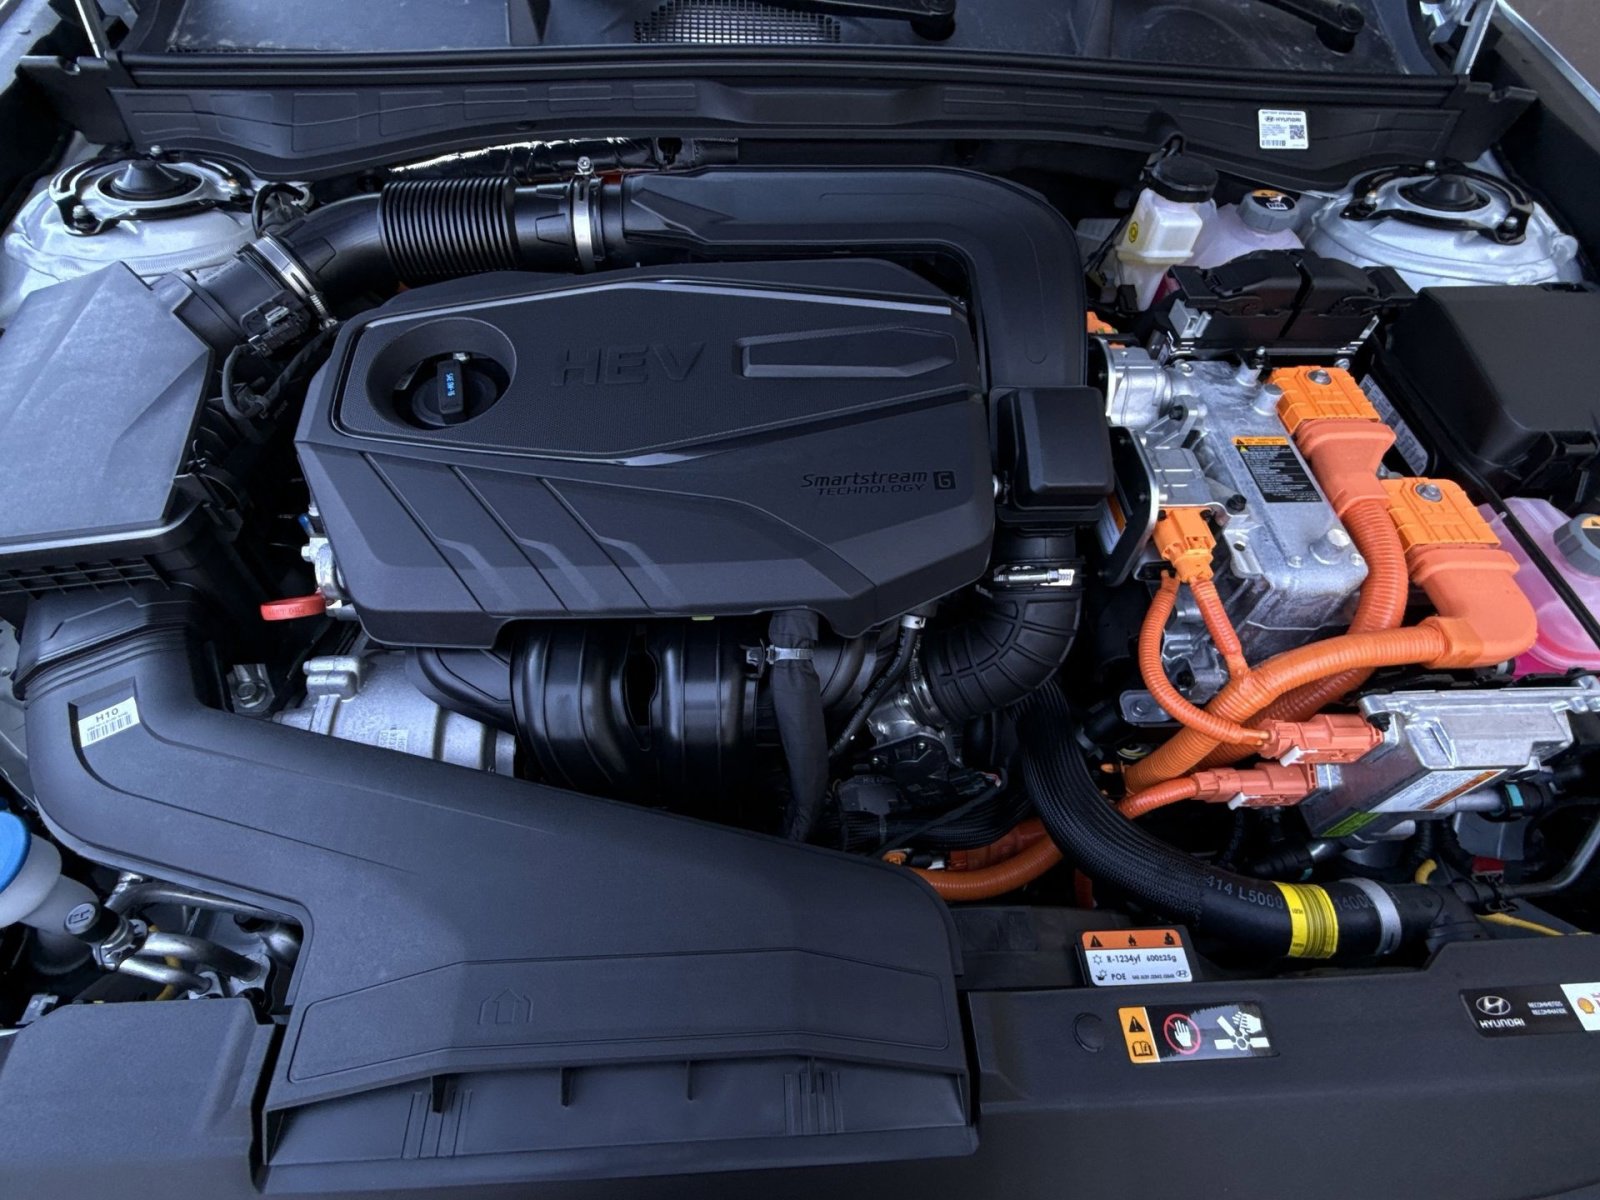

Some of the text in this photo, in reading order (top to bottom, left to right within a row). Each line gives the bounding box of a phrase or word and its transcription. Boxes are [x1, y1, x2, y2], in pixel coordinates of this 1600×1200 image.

[551, 343, 707, 387] HEV
[800, 471, 928, 488] Smartstream
[816, 483, 926, 496] TECHNOLOGY
[95, 707, 119, 723] H10
[1111, 973, 1127, 981] POE
[1479, 1018, 1526, 1029] HYUNDAI
